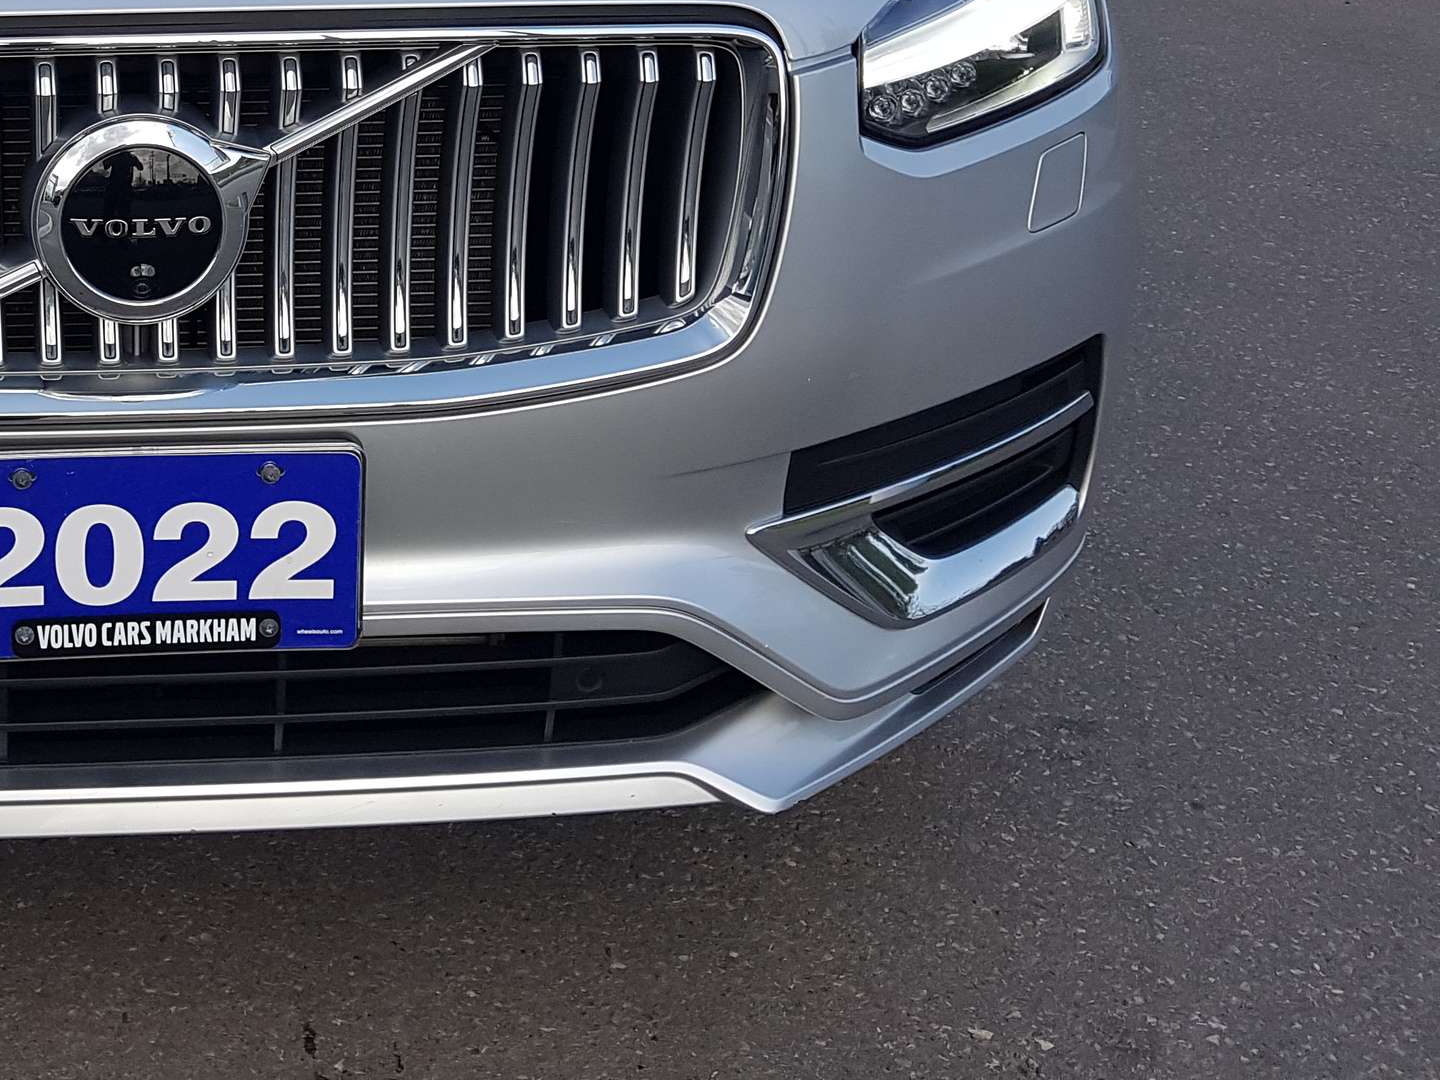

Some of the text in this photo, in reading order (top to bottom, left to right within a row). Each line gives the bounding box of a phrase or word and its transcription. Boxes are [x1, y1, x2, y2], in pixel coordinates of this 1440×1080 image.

[70, 216, 211, 238] VOLVO
[37, 618, 257, 649] VOLVO CARS MARKHAM
